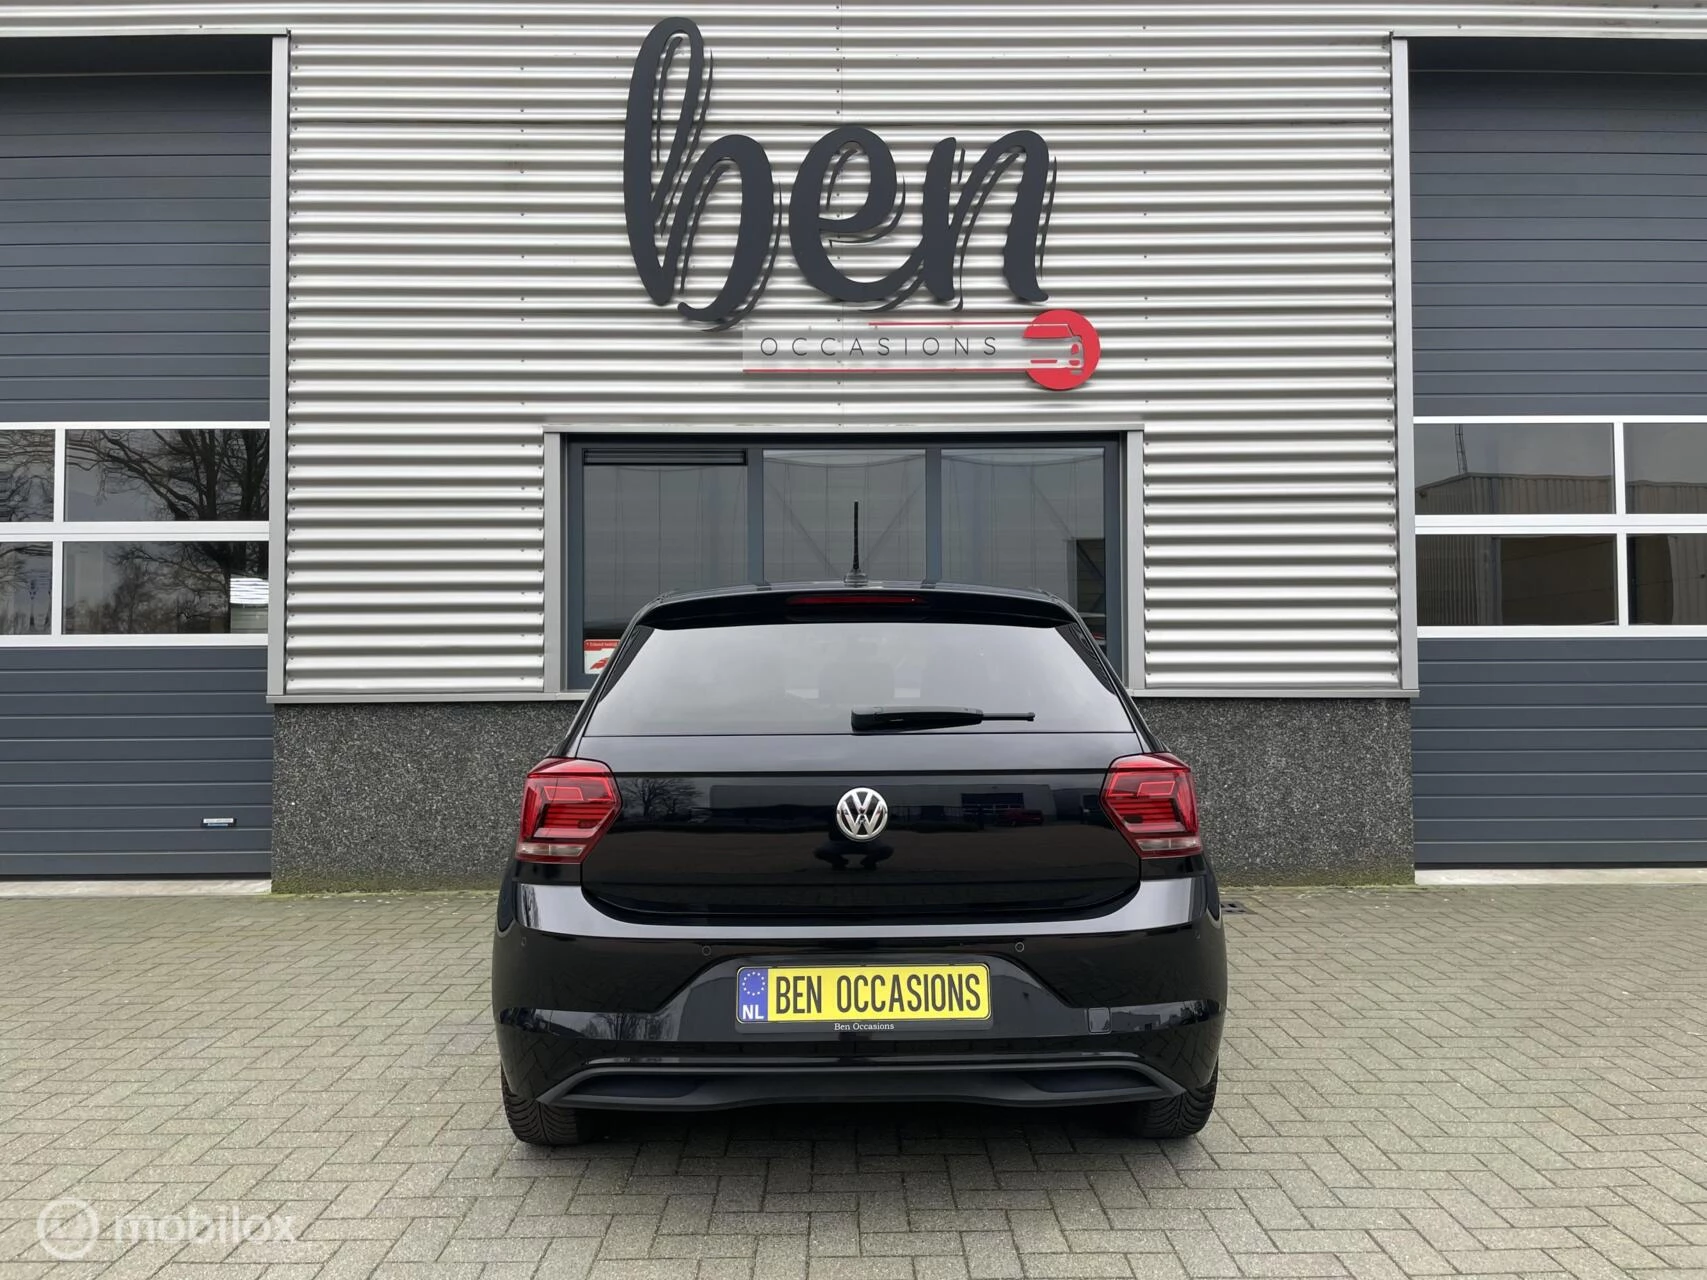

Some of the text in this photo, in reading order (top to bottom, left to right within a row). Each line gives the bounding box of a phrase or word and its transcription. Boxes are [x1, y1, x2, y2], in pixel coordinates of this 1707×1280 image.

[624, 17, 1054, 328] ben
[760, 336, 997, 357] OCCASIONS
[775, 973, 981, 1014] BEN OCCASIONS
[742, 1004, 764, 1020] NL
[834, 1022, 895, 1031] Ben Occasions
